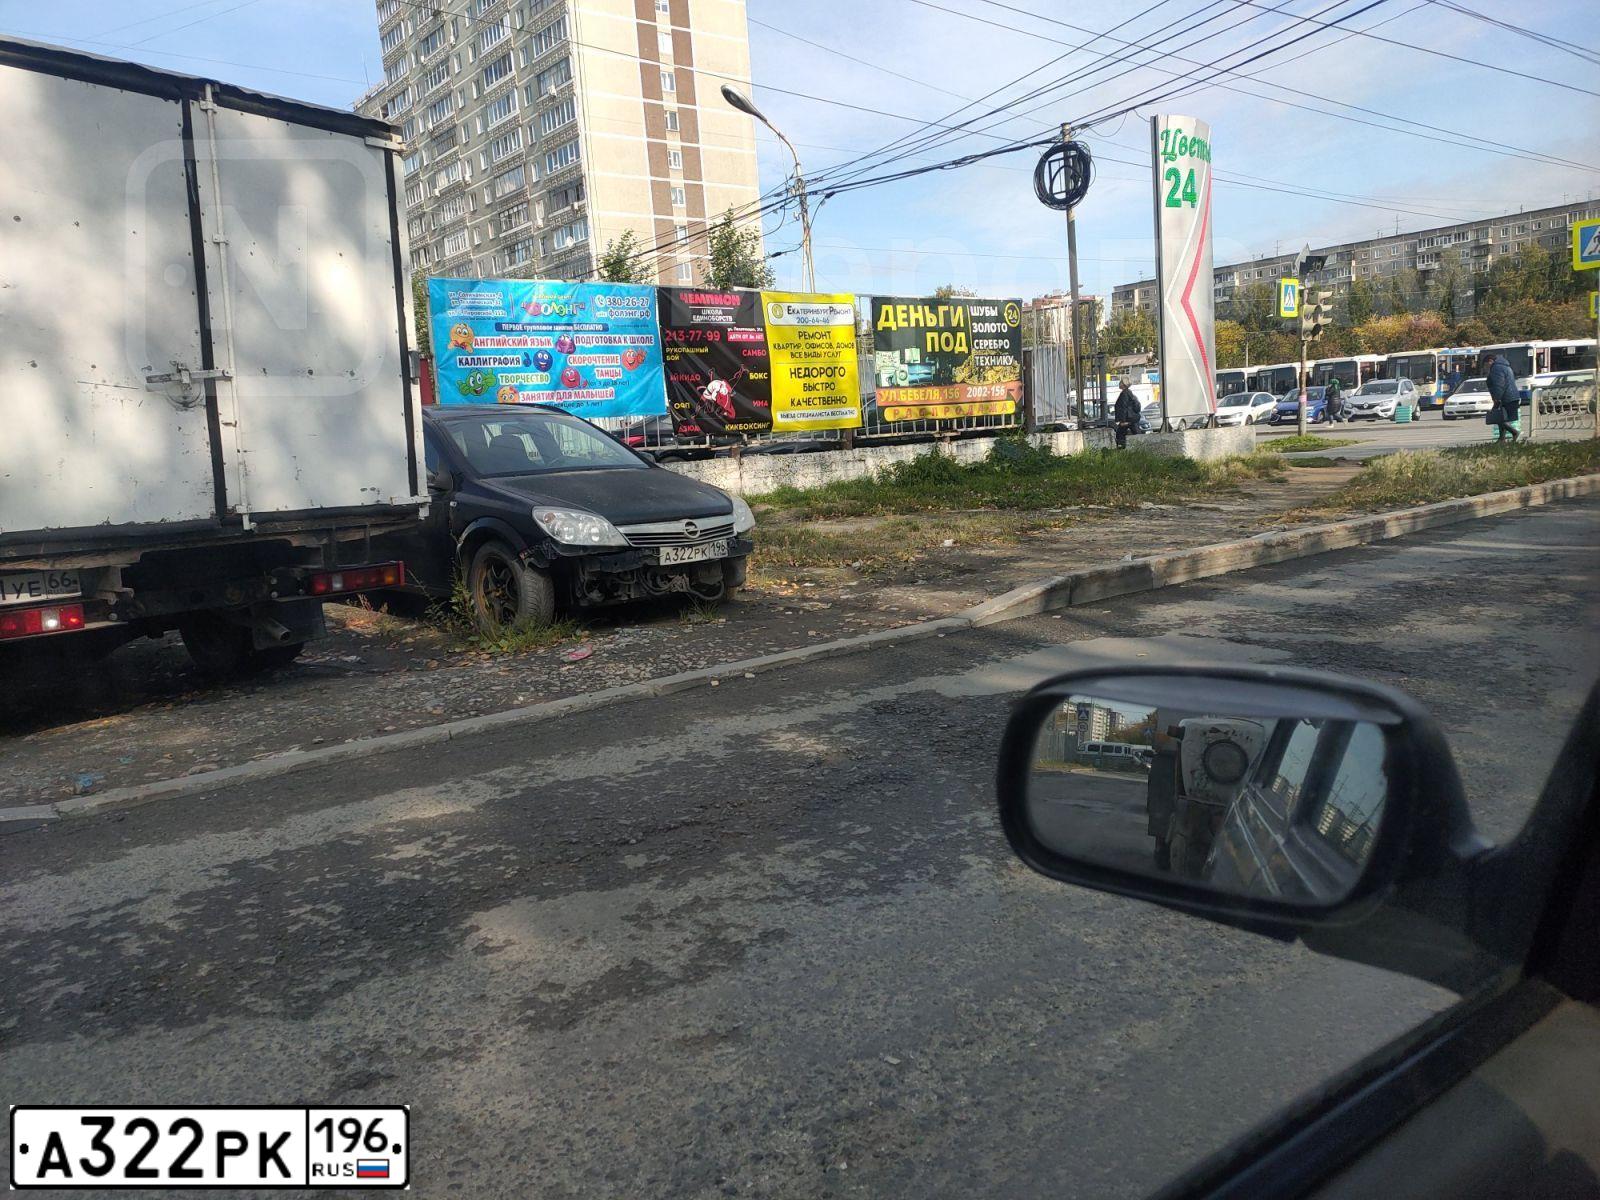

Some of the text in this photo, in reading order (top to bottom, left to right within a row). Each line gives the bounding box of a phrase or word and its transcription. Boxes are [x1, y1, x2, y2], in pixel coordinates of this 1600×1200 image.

[1165, 167, 1197, 208] 24
[606, 297, 650, 307] 380-26-27
[680, 293, 741, 306] ЧЕМПИОН
[608, 309, 652, 319] фолэнг.рф
[970, 306, 998, 317] ШУБЫ
[1007, 309, 1018, 320] 24
[796, 316, 830, 324] 200-64-46
[877, 304, 965, 331] ДЕНЬГИ
[501, 323, 523, 331] ПЕРВОЕ
[573, 323, 603, 331] БЕСПЛАТНО
[972, 323, 1008, 333] ЗОЛОТО
[575, 336, 654, 345] ПОДГОТОВКА К ШКОЛЕ
[666, 330, 720, 342] 213-77-99
[798, 331, 831, 340] РЕМОНТ
[474, 336, 552, 347] АНГЛИЙСКИЙ ЯЗЫК
[805, 342, 834, 350] ОФИСОВ,
[926, 331, 968, 354] ПОД
[973, 339, 1010, 350] СЕРЕБРО
[742, 349, 767, 357] САМБО
[790, 351, 842, 359] ВСЕ ВИДЫ УСЛУГ
[458, 356, 520, 366] КАЛЛИГРАФИЯ
[568, 355, 619, 364] СКОРОЧТЕНИЕ
[974, 355, 1014, 366] ТЕХНИКУ
[596, 369, 621, 378] ТАНЦЫ
[749, 372, 768, 380] БОКС
[789, 366, 846, 379] НЕДОРОГО
[500, 374, 549, 383] ТВОРЧЕСТВО
[803, 382, 836, 392] БЫСТРО
[967, 386, 1006, 398] 2002-156
[521, 389, 614, 401] ЗАНЯТИЯ ДЛЯ МАЛЫШЕЙ
[674, 402, 690, 410] ОФП
[790, 396, 848, 407] КАЧЕСТВЕННО
[797, 411, 830, 419] СПЕЦИАЛИСТА
[725, 422, 770, 431] КИКБОКСИНГ
[710, 542, 726, 554] 196
[48, 573, 72, 589] 66
